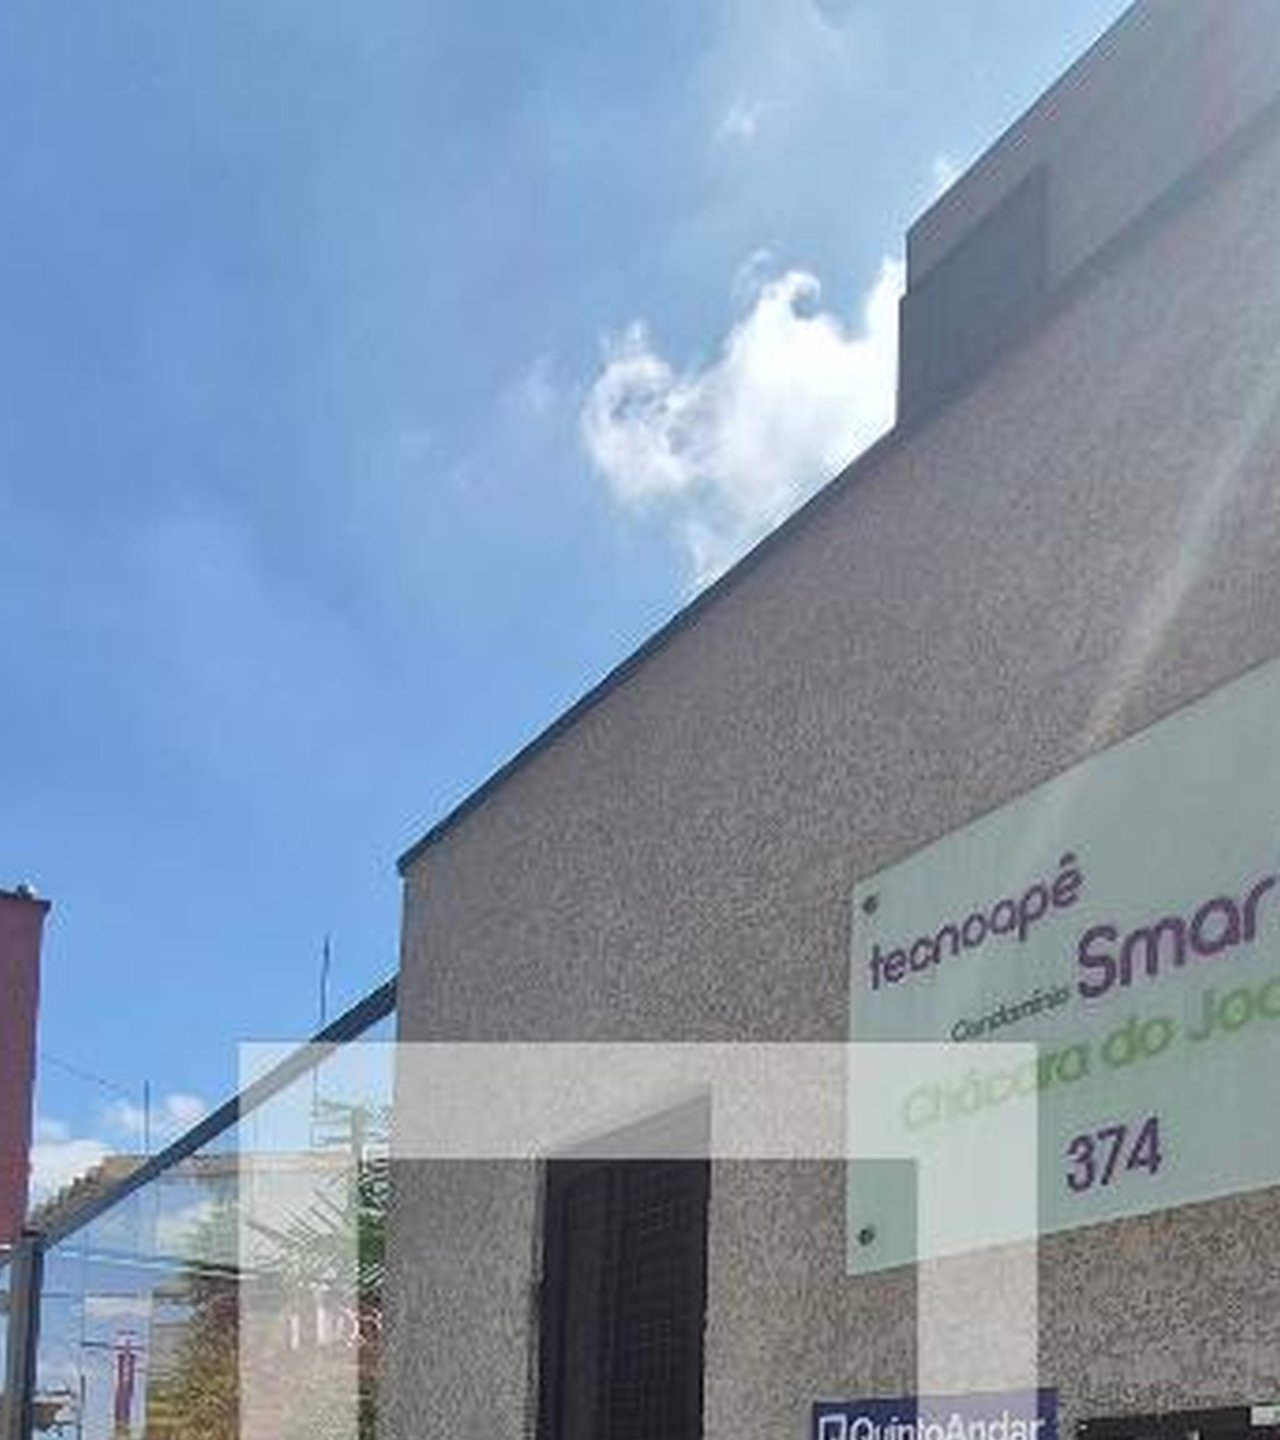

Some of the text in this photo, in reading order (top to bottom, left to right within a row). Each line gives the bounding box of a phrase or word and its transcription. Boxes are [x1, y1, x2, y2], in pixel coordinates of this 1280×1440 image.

[868, 852, 1084, 990] tecnoapê
[1099, 1006, 1175, 1072] do
[1065, 1116, 1163, 1194] 374
